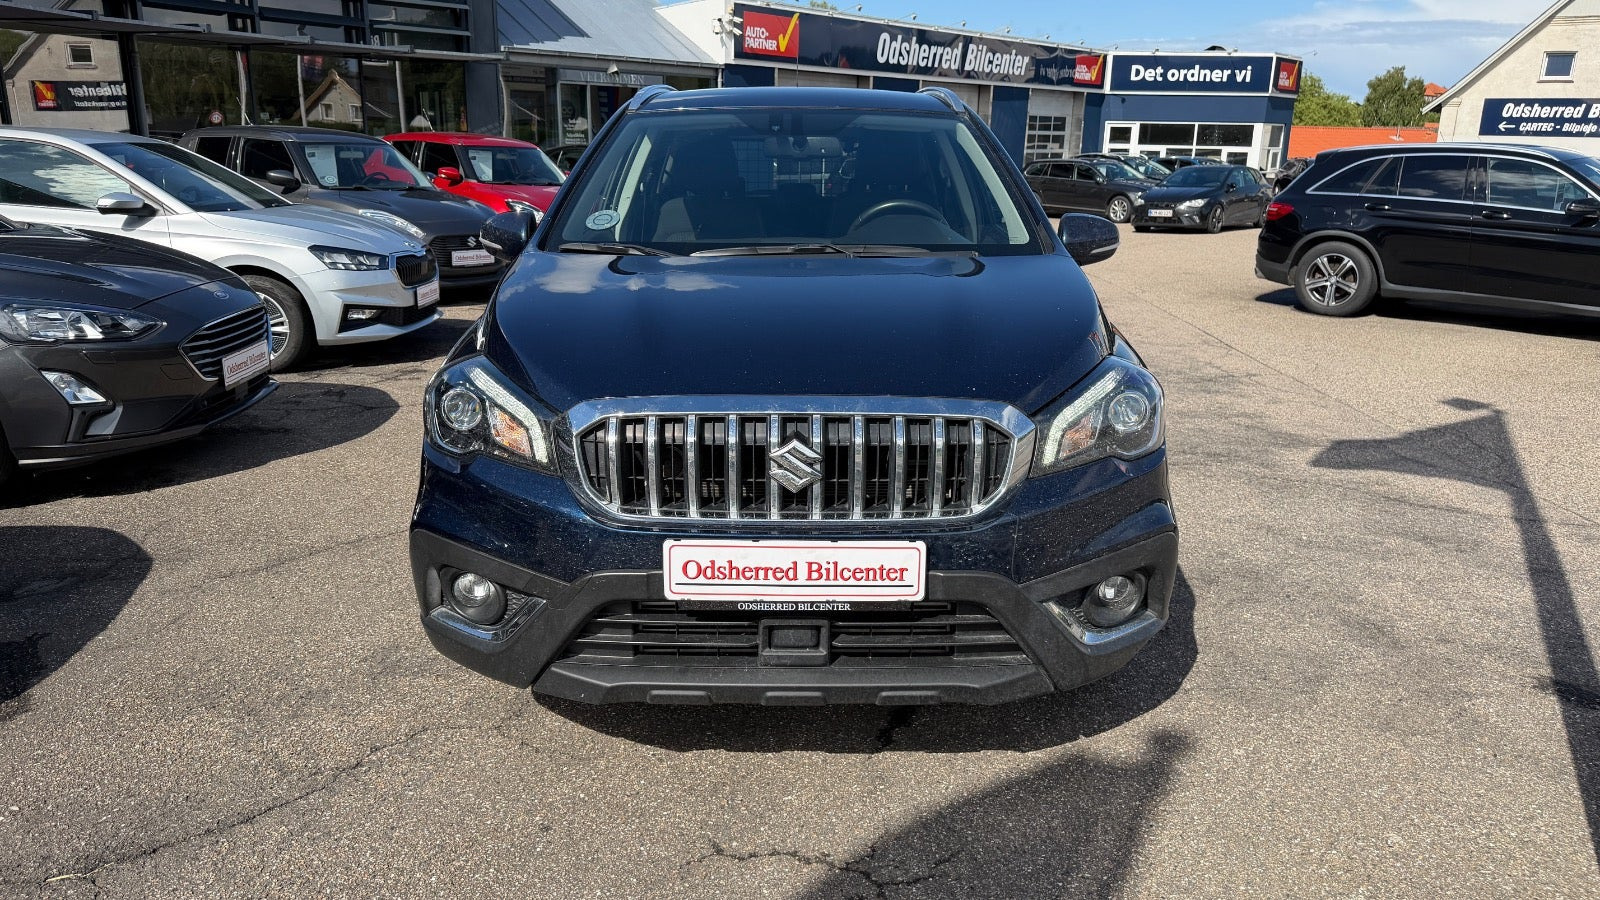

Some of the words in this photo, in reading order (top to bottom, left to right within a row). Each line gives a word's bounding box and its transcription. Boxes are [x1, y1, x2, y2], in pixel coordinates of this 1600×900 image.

[745, 26, 769, 39] AUTO-
[745, 37, 778, 51] PARTNER
[876, 32, 963, 70] Odsherred
[964, 43, 1030, 76] Bilcenter
[1130, 64, 1164, 81] Det
[1167, 65, 1231, 82] ordner
[1235, 65, 1253, 83] vi
[1502, 103, 1586, 118] Odsherred
[1588, 103, 1600, 118] B
[1519, 122, 1555, 131] CARTEC
[226, 356, 249, 375] Odsherred
[681, 559, 798, 581] Odsherred
[805, 561, 909, 581] Bilcenter
[737, 602, 796, 611] ODSHERRED
[798, 602, 851, 611] BILCENTER
